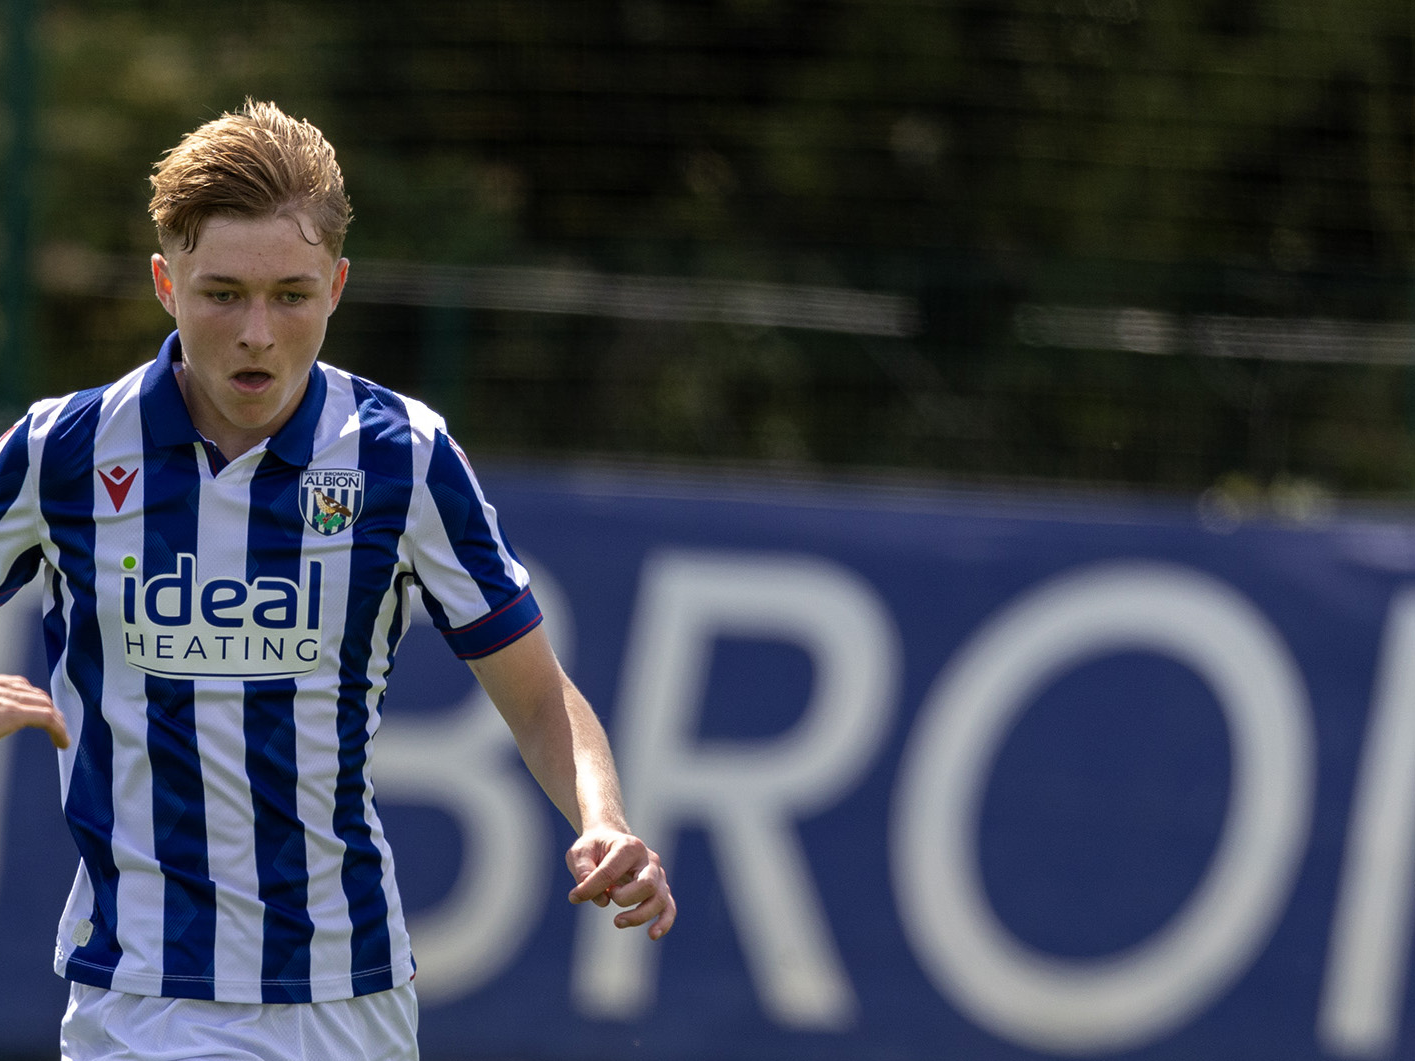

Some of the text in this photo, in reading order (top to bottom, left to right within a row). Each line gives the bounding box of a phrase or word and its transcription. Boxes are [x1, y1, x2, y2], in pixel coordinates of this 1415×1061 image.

[304, 476, 360, 489] ALBION
[122, 555, 322, 631] ideal
[125, 632, 319, 663] HEATING
